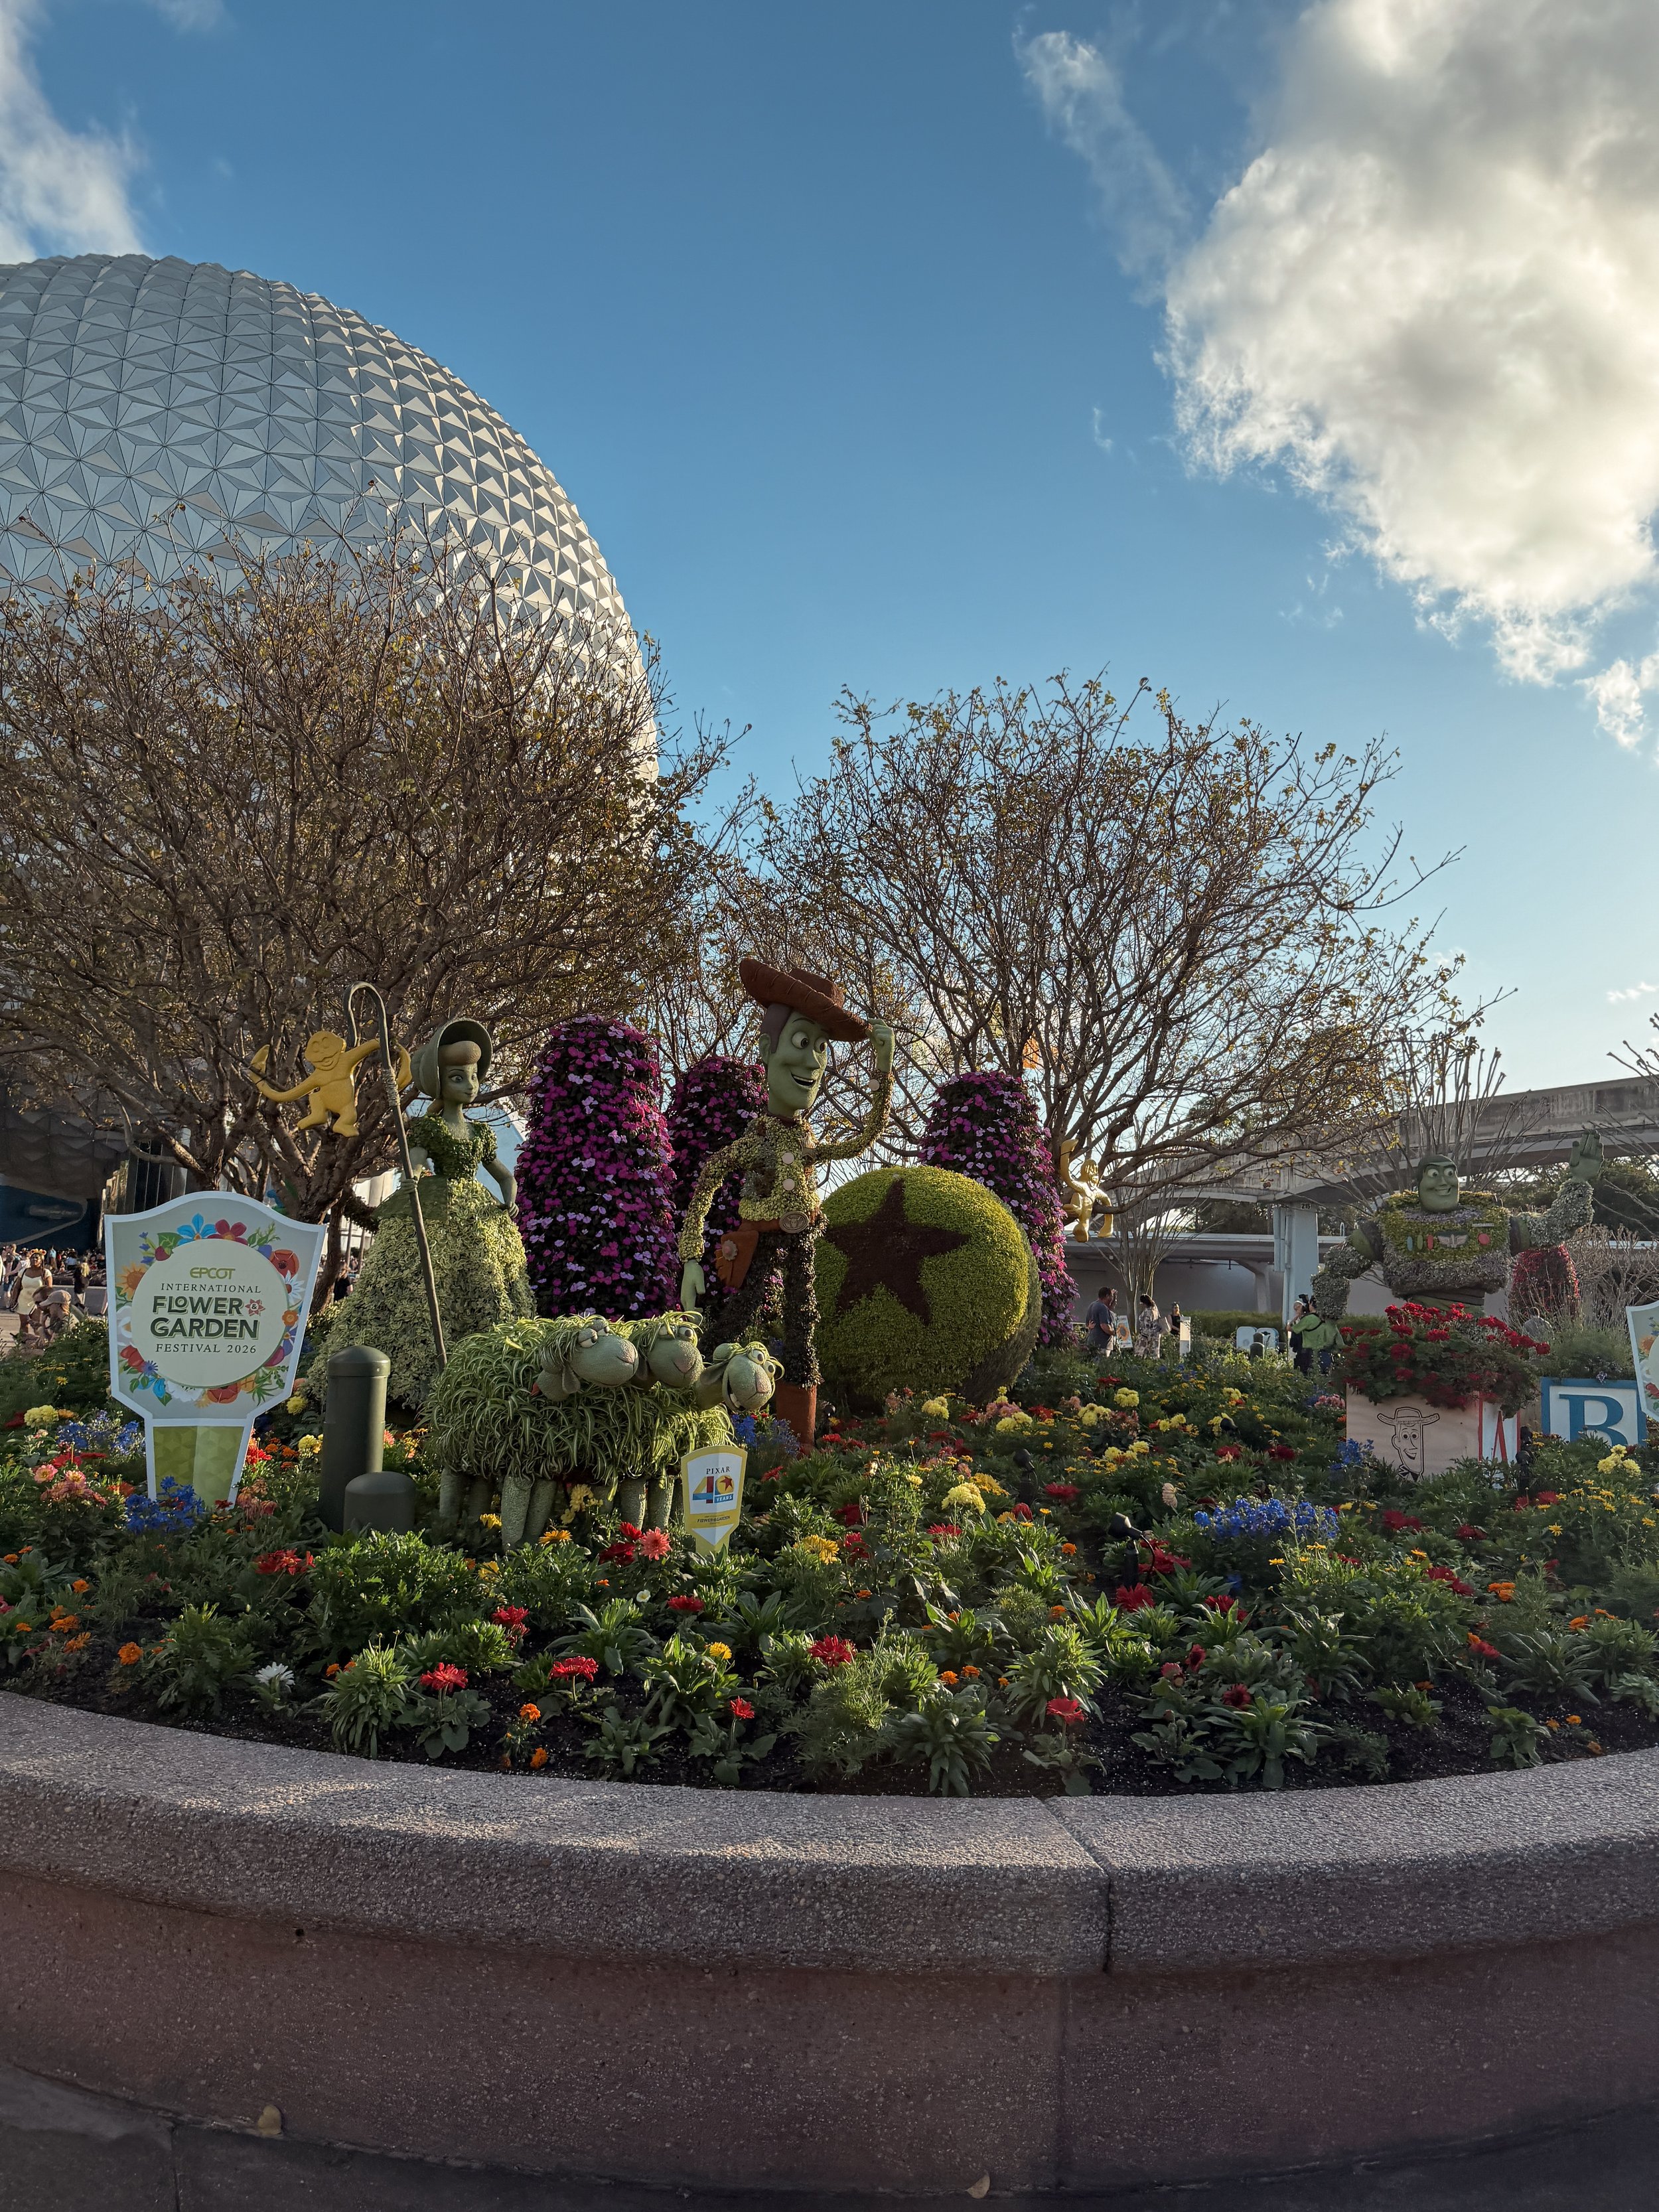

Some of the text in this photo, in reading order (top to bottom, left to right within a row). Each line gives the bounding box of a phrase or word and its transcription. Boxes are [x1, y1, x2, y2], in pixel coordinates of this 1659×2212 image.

[190, 1267, 236, 1280] EPCOT
[161, 1283, 261, 1293] INTERNATIONAL
[153, 1295, 244, 1315] FLOWER
[150, 1317, 259, 1340] GARDEN
[155, 1344, 256, 1353] FESTIVAL 2026
[1559, 1394, 1628, 1446] B
